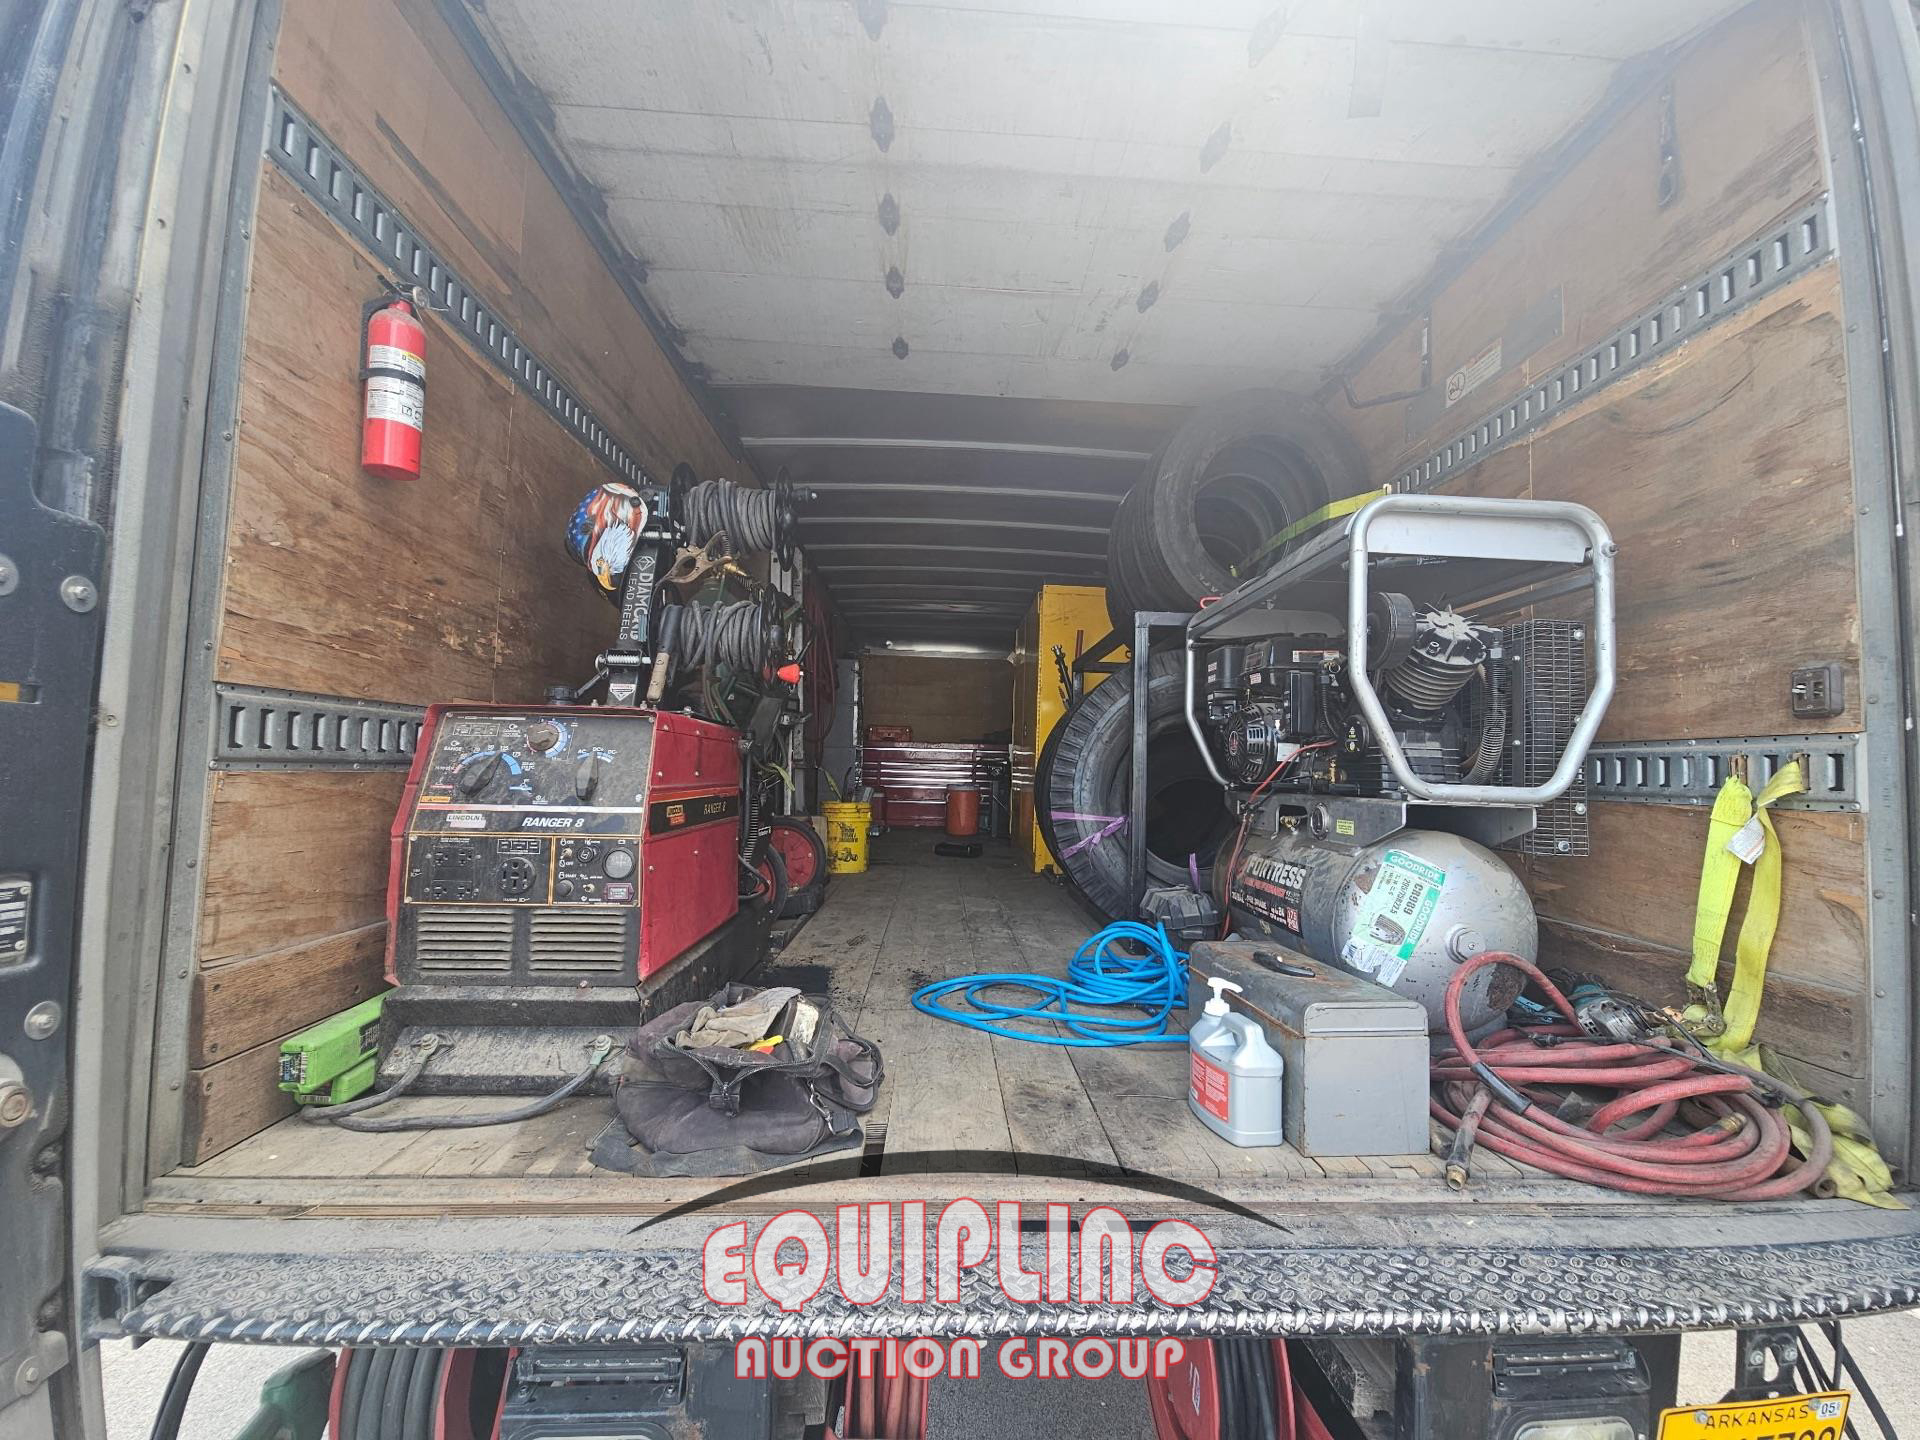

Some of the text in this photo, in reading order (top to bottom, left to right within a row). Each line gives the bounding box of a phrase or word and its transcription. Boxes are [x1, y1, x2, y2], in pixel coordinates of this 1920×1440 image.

[620, 572, 638, 640] LEAD REELS
[703, 802, 721, 815] RANGER
[521, 817, 585, 828] RANGER 8
[1245, 855, 1307, 890] FORTRESS
[1390, 855, 1441, 881] GOODRIDE
[1403, 883, 1424, 915] CR989
[1406, 900, 1433, 944] GOODRIDE
[1704, 1404, 1809, 1430] ARKANSAS
[1821, 1402, 1836, 1415] 05
